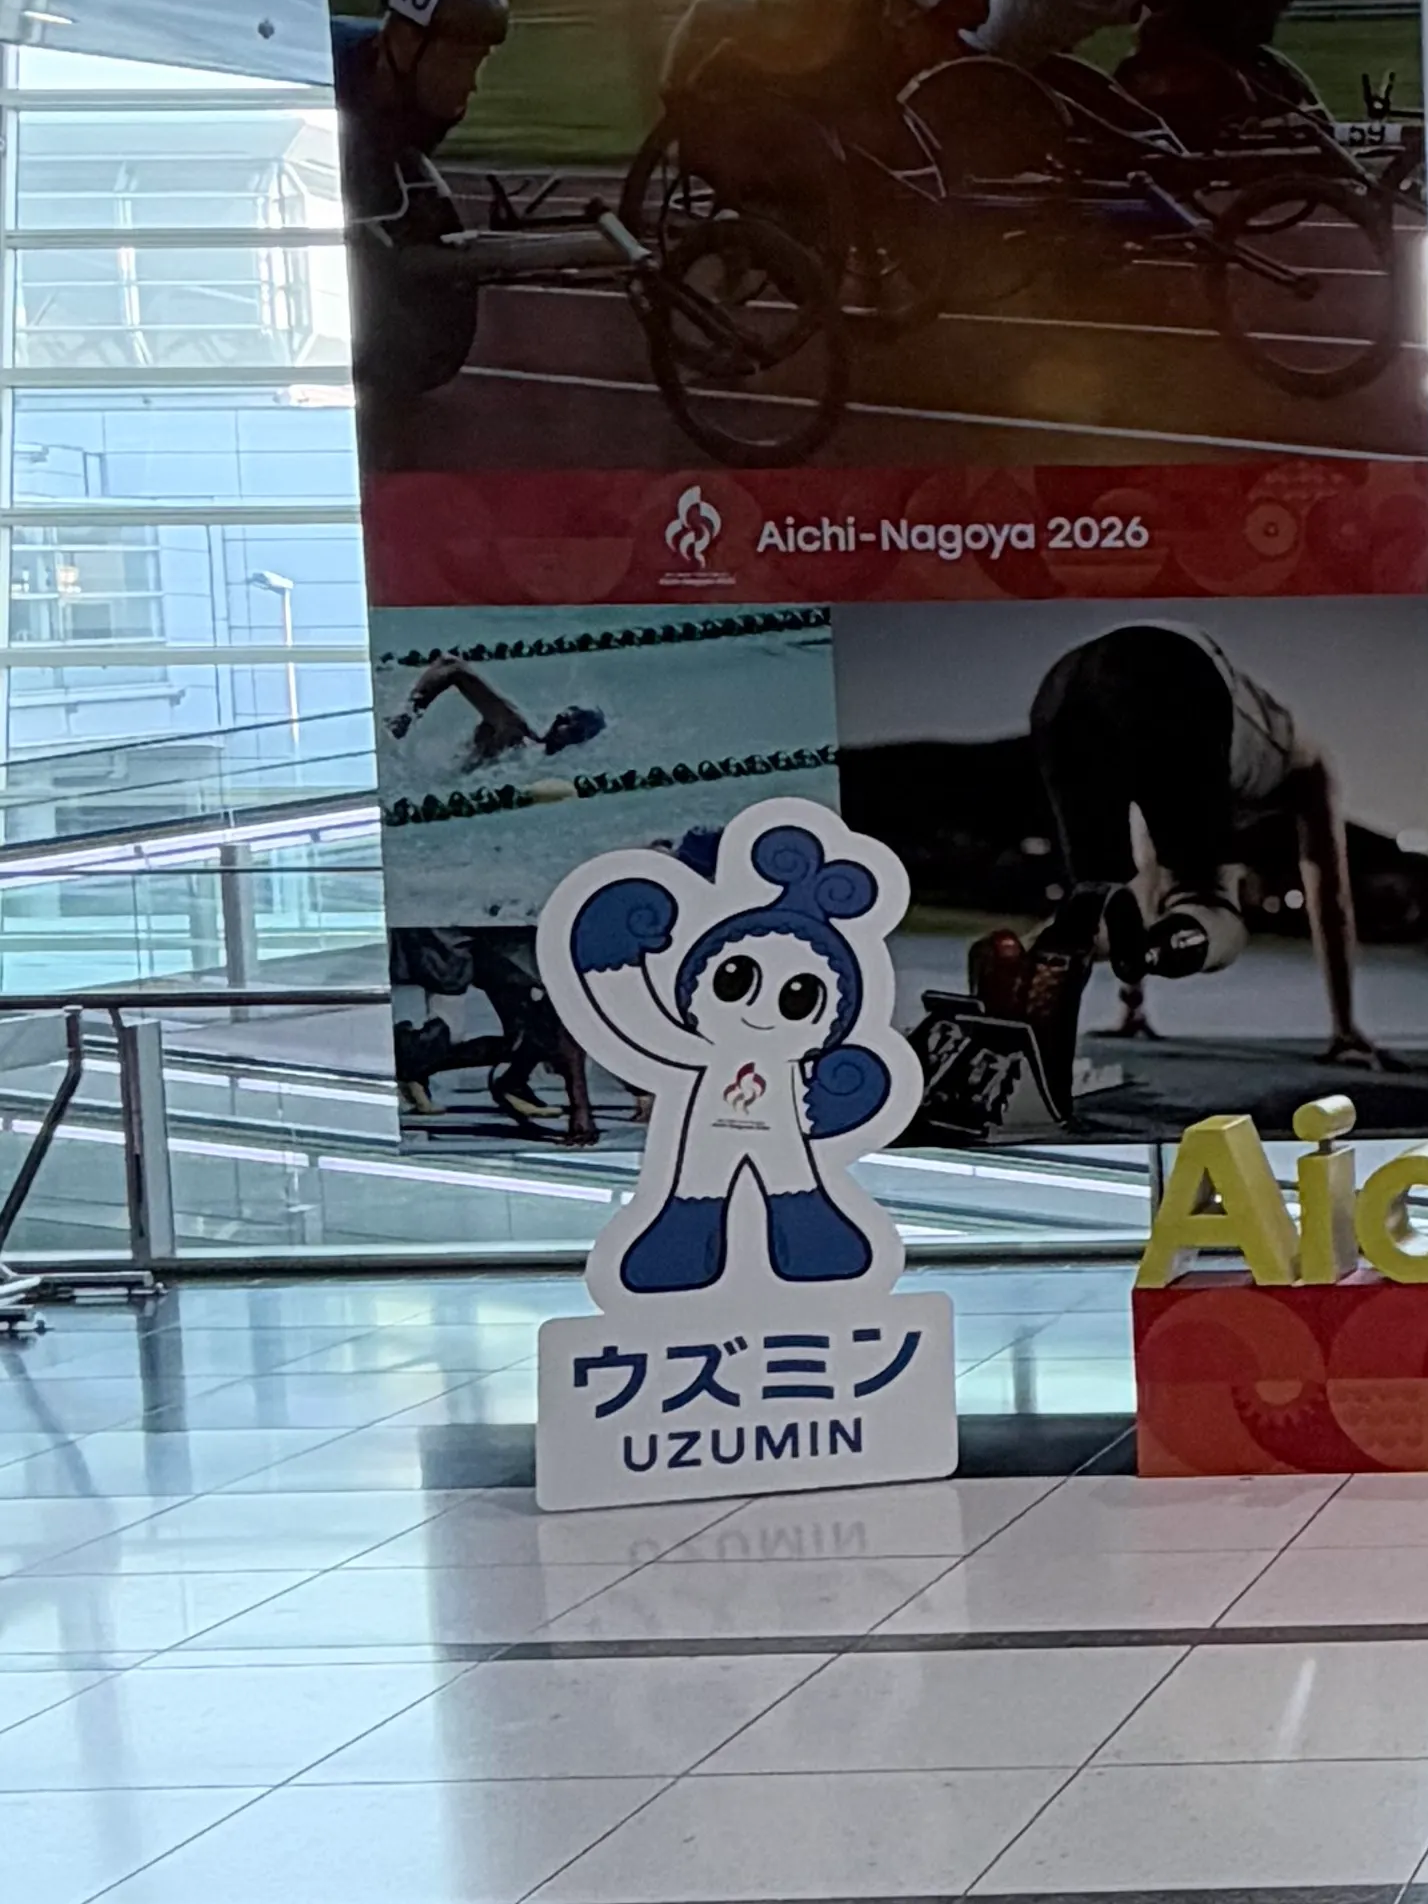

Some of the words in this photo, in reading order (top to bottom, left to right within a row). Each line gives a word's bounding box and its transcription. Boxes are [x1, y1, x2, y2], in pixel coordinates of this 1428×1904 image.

[757, 517, 1034, 560] Aichi-Nagoya
[1048, 517, 1148, 548] 2026
[573, 1328, 922, 1419] ウズミン
[624, 1418, 862, 1472] UZUMIN
